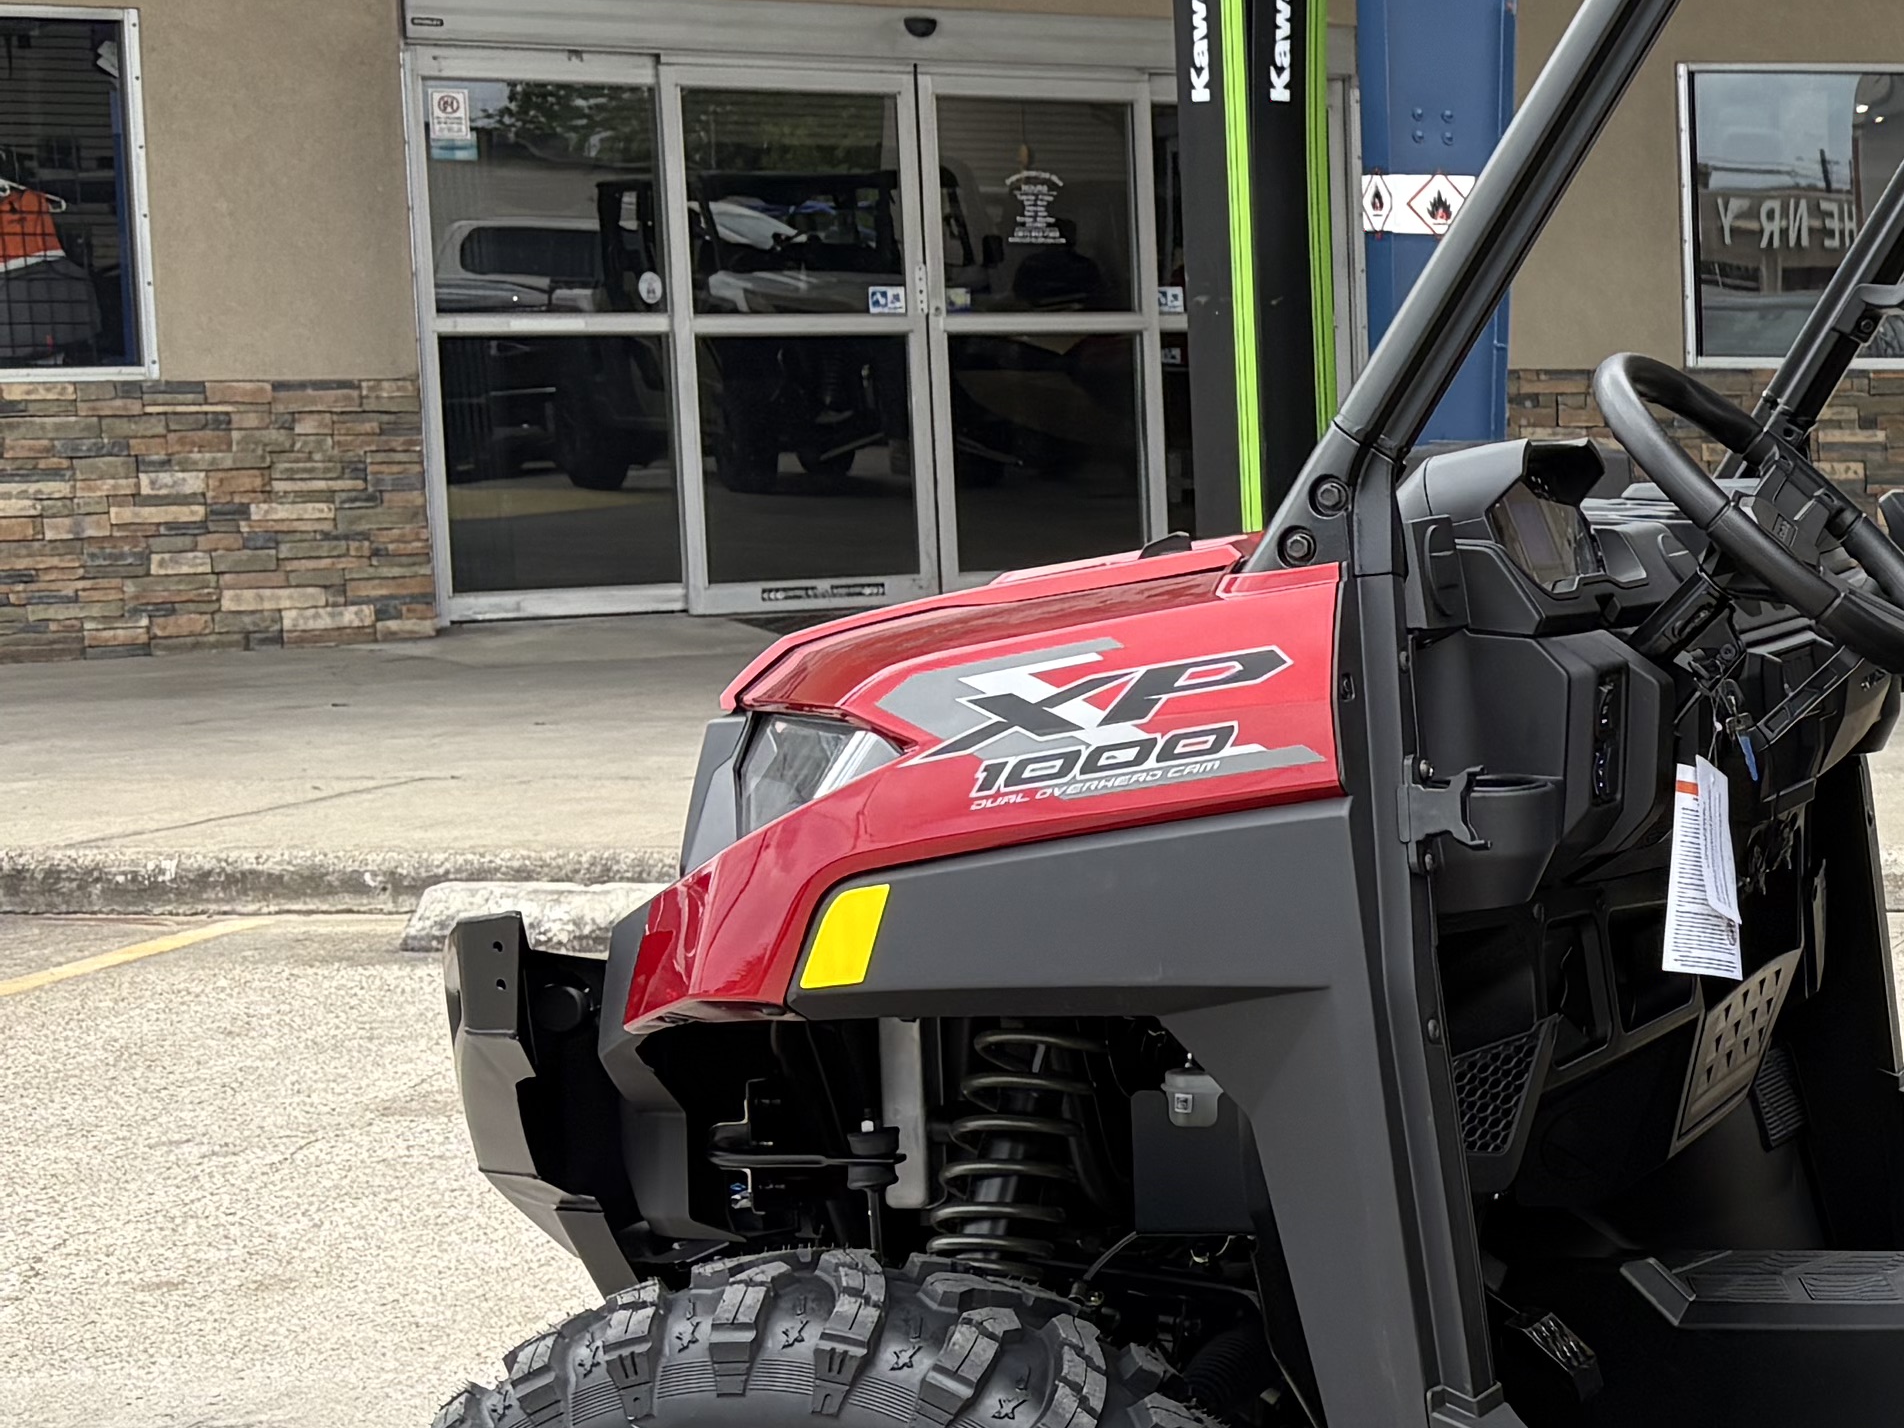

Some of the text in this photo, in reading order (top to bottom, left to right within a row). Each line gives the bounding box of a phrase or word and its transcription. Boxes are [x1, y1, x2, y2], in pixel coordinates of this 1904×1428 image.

[897, 645, 1294, 767] XP
[969, 721, 1240, 798] 1000
[970, 760, 1221, 811] DUAL OVERHEAD CAM
